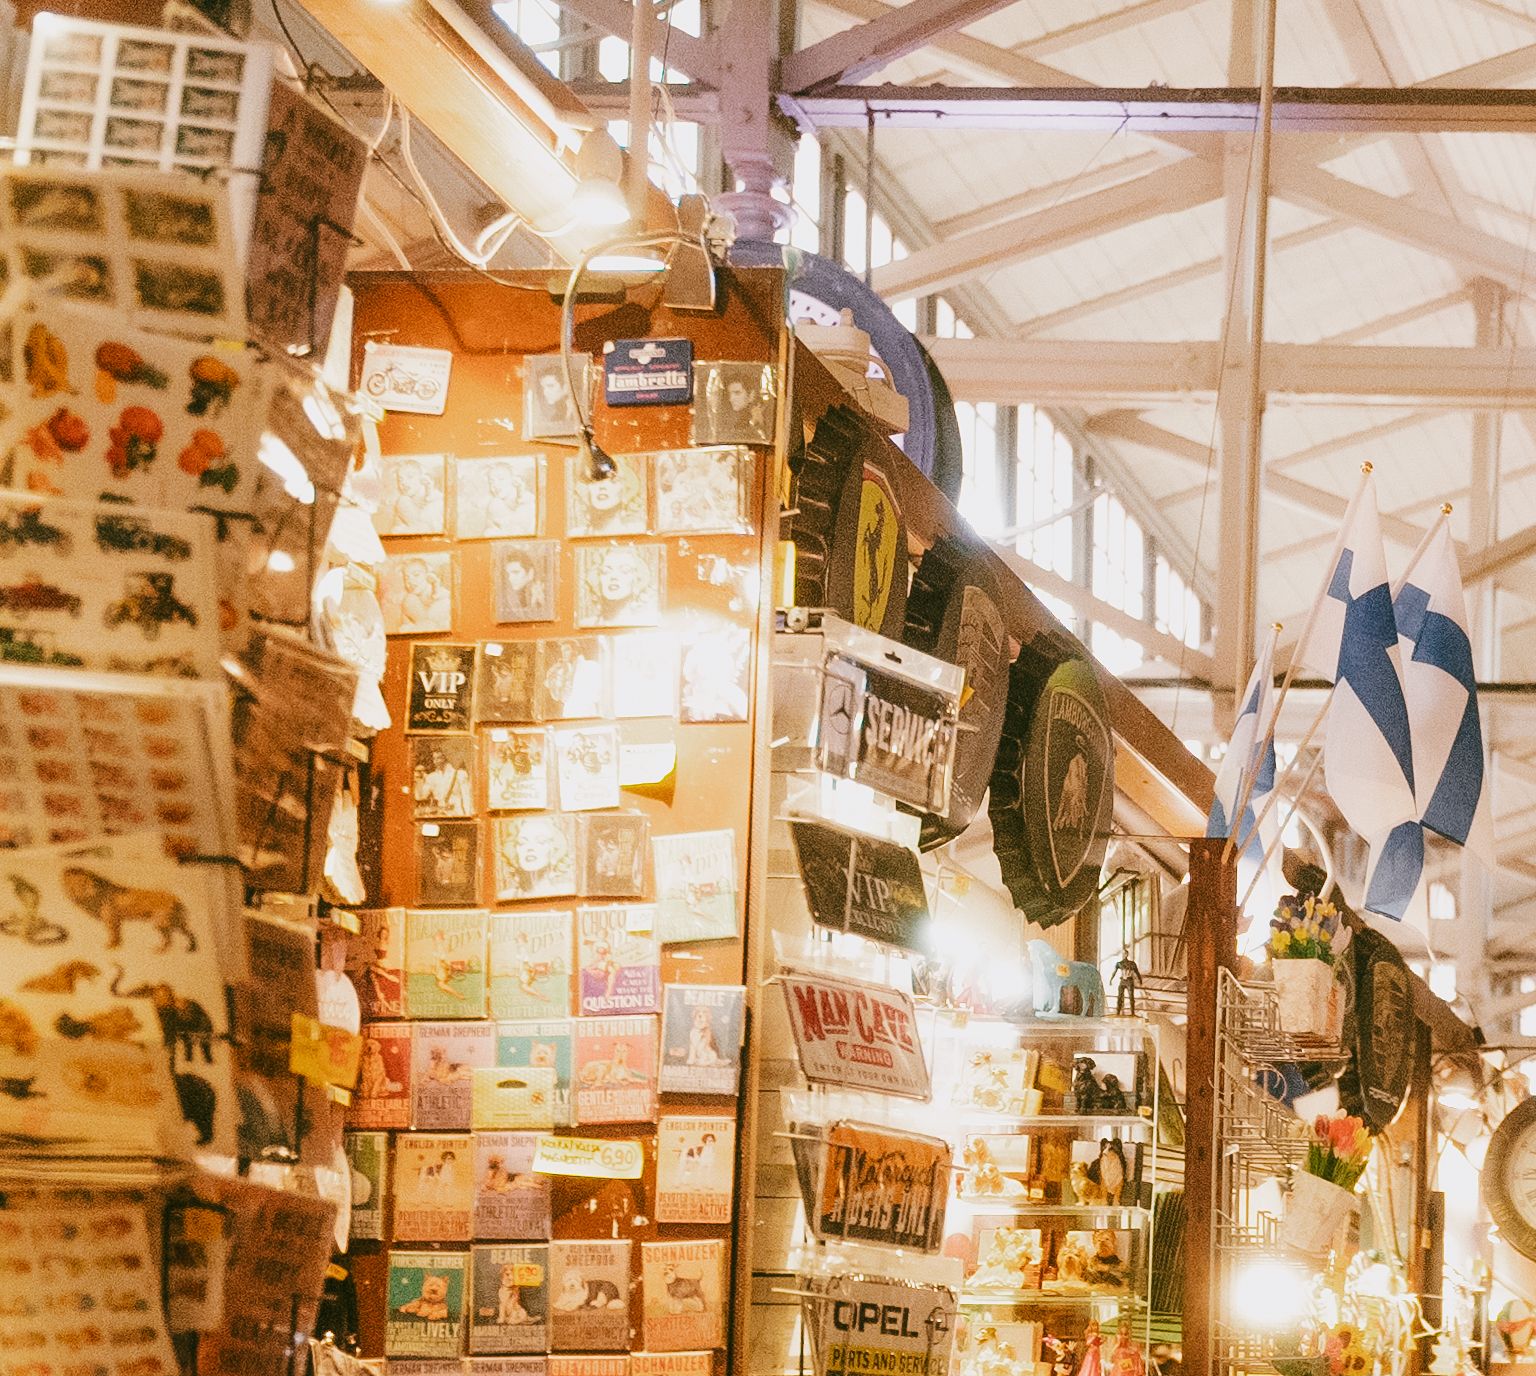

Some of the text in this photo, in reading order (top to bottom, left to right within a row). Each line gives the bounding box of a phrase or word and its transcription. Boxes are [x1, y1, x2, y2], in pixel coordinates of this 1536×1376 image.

[418, 671, 467, 694] VIP
[424, 698, 456, 710] ONLY
[842, 867, 890, 912] VIP
[583, 994, 655, 1011] QUESTION IS
[793, 985, 914, 1046] MAN CAVE
[579, 1021, 651, 1037] GREYHOUND
[700, 1203, 729, 1216] ACTIVE
[490, 1249, 531, 1264] BEAGLE
[565, 1254, 616, 1267] SHEEPDOG
[645, 1246, 717, 1264] SCHNAUZER
[833, 1300, 919, 1338] OPEL
[420, 1322, 460, 1338] LIVELY
[634, 1356, 706, 1373] SCHNAUZER
[832, 1347, 870, 1369] PARTS
[873, 1351, 897, 1371] AND
[551, 1360, 624, 1376] GREYHOUND
